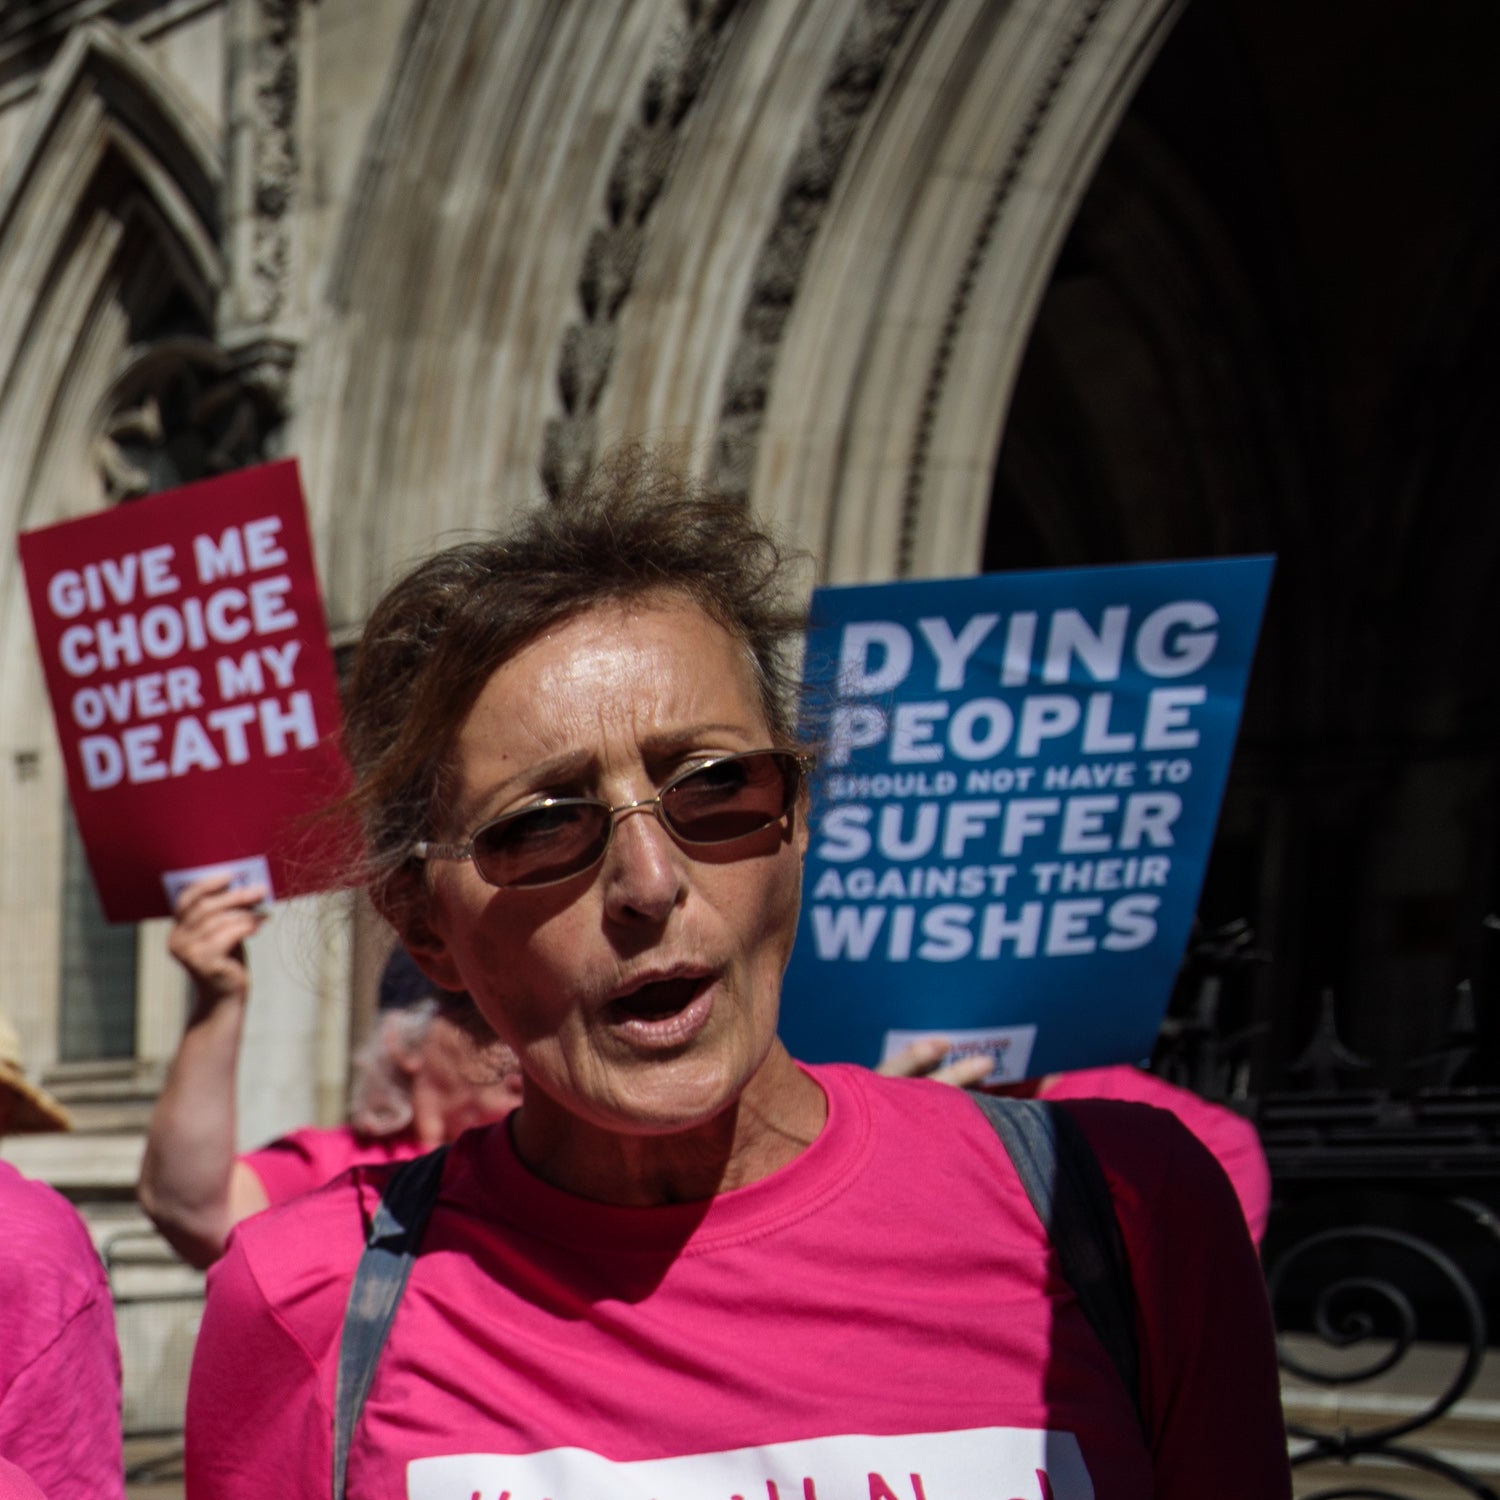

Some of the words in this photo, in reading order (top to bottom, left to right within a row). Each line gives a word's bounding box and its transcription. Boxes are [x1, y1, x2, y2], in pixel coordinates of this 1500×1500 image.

[49, 545, 180, 619] GIVE
[194, 515, 287, 584] ME
[60, 575, 297, 677] CHOICE
[837, 600, 1220, 695] DYING
[73, 667, 203, 729] OVER
[216, 640, 299, 698] MY
[828, 686, 1206, 765] PEOPLE
[80, 692, 318, 791] DEATH
[827, 771, 956, 799] SHOULD
[967, 767, 1034, 793] NOT
[1045, 761, 1135, 790] HAVE
[1148, 758, 1191, 784] TO
[819, 792, 1182, 863] SUFFER
[815, 865, 1016, 899] AGAINST
[1031, 856, 1171, 893] THEIR
[811, 895, 1161, 962] WISHES
